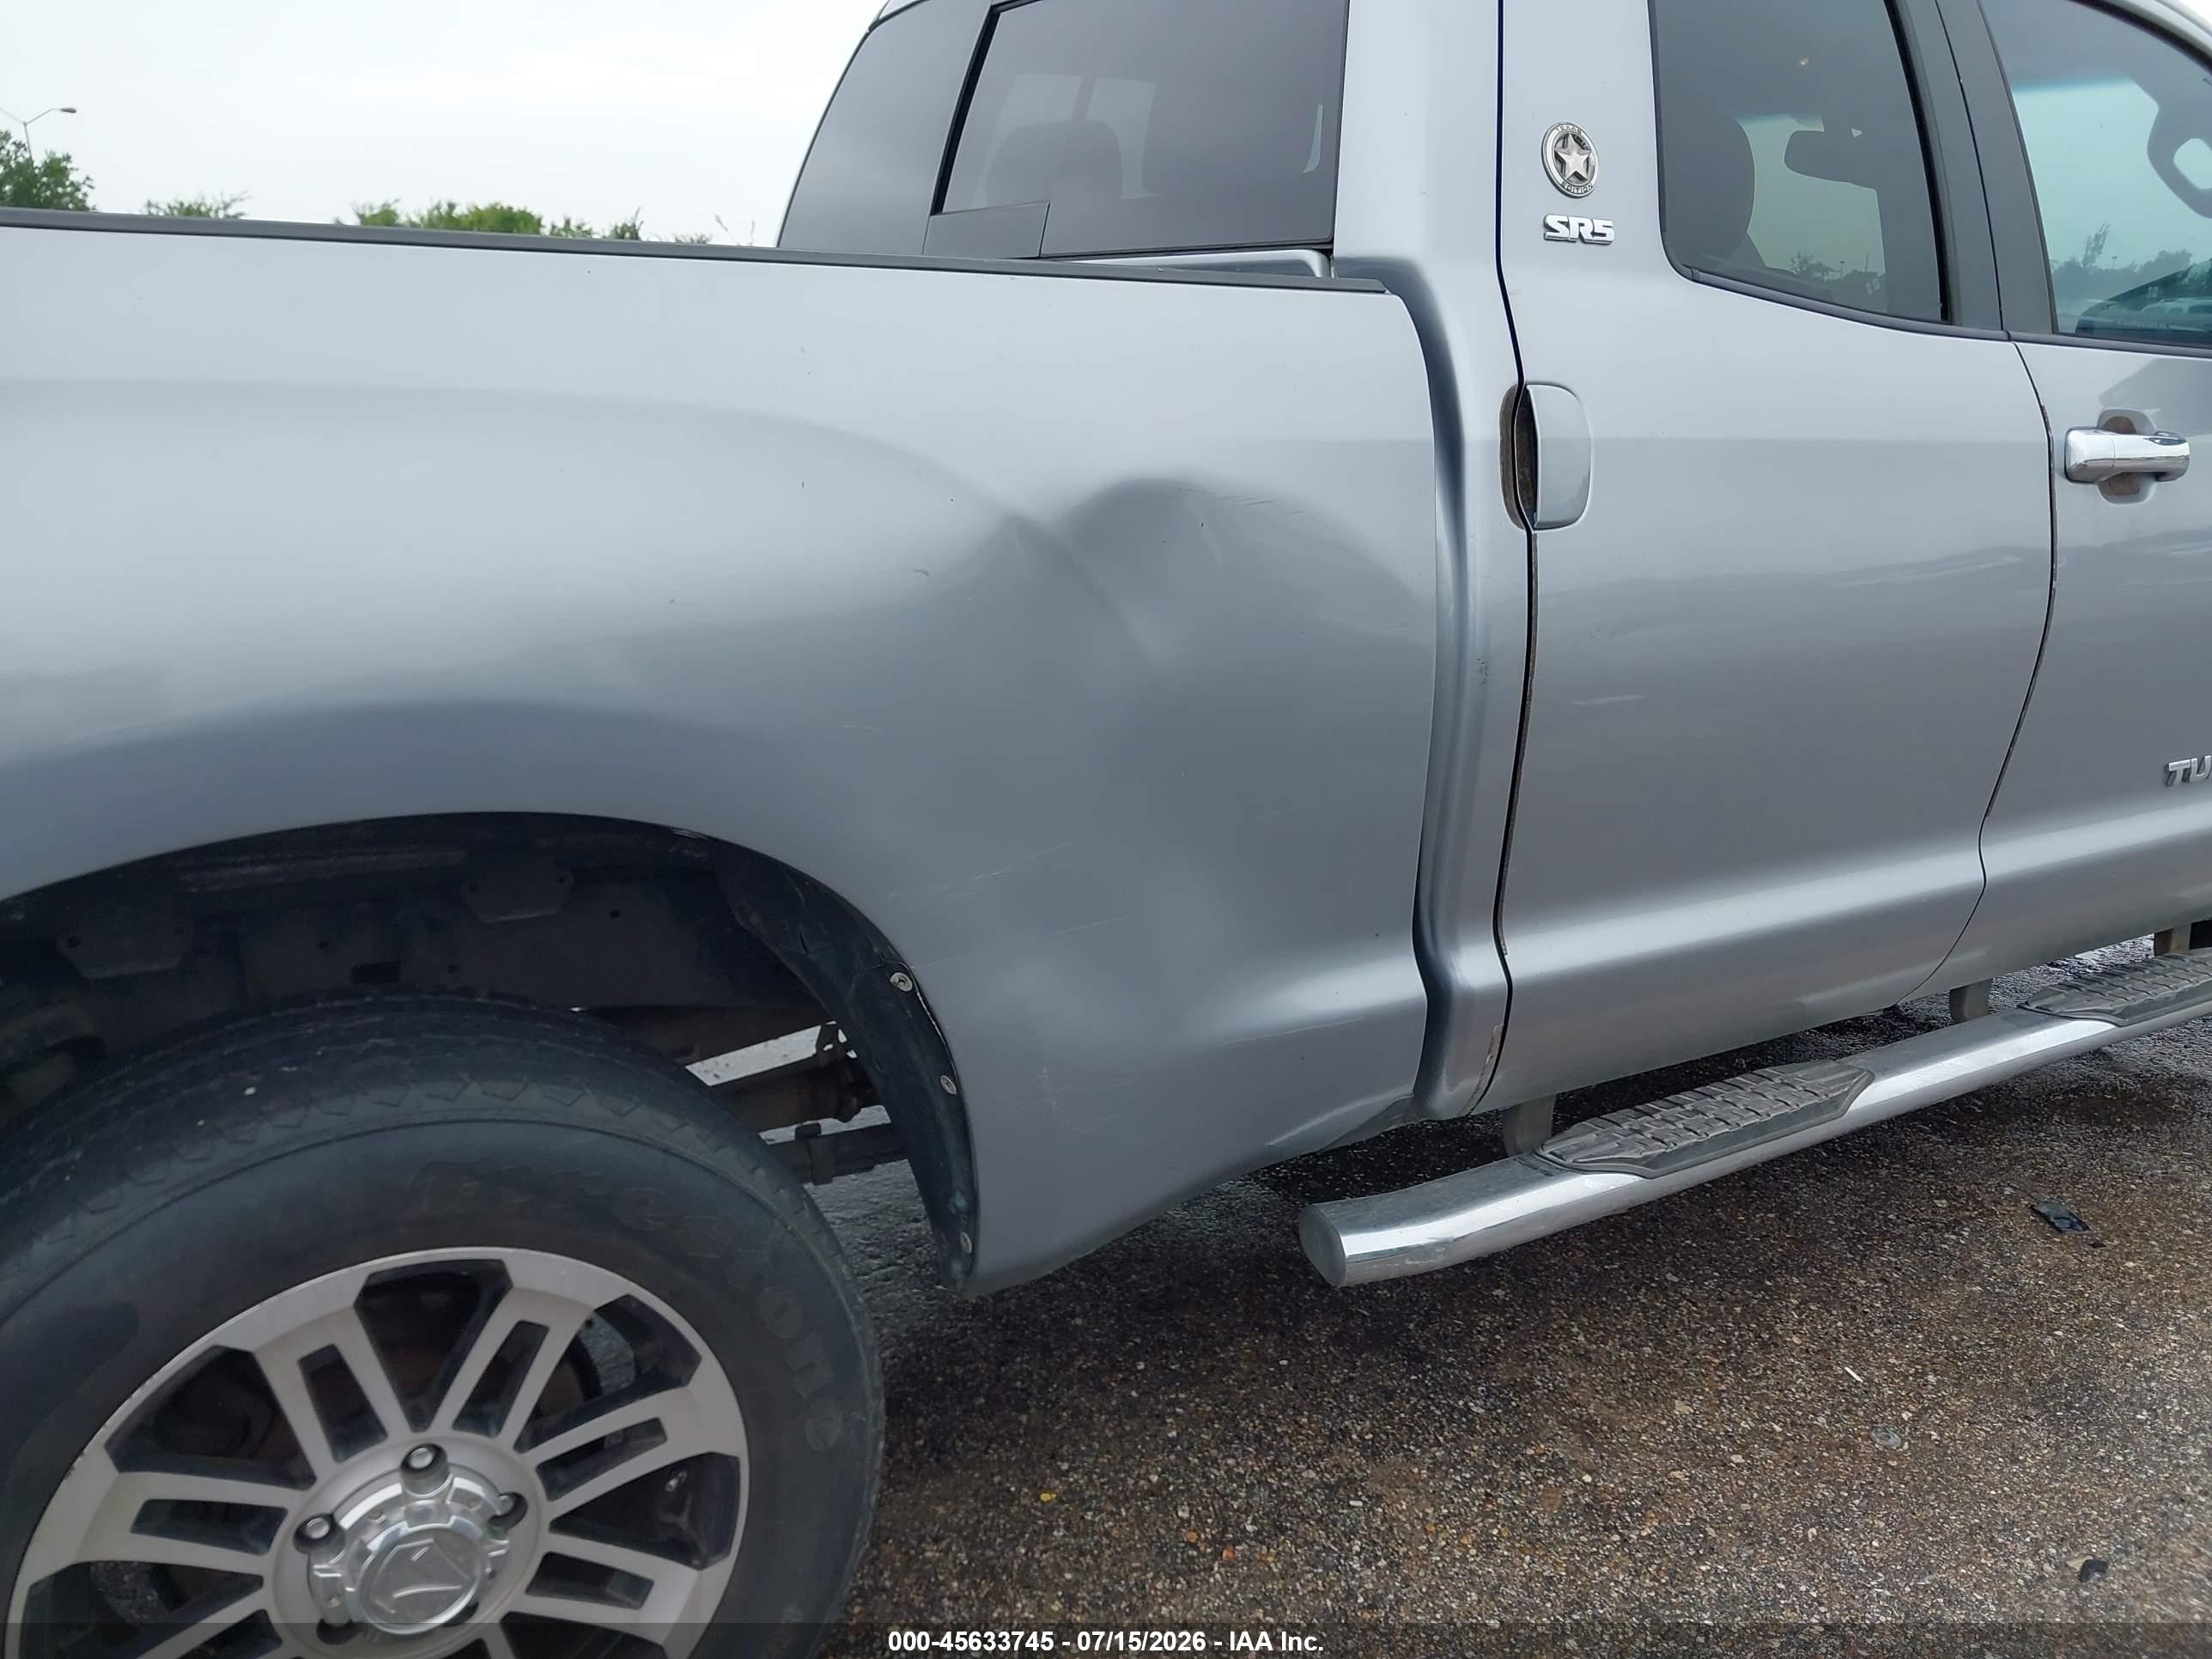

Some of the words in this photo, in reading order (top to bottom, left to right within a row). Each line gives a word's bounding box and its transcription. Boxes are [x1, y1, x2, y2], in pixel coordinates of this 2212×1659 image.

[1555, 125, 1583, 136] TEXAS
[1560, 180, 1595, 195] EDITION
[1543, 214, 1615, 246] SR5
